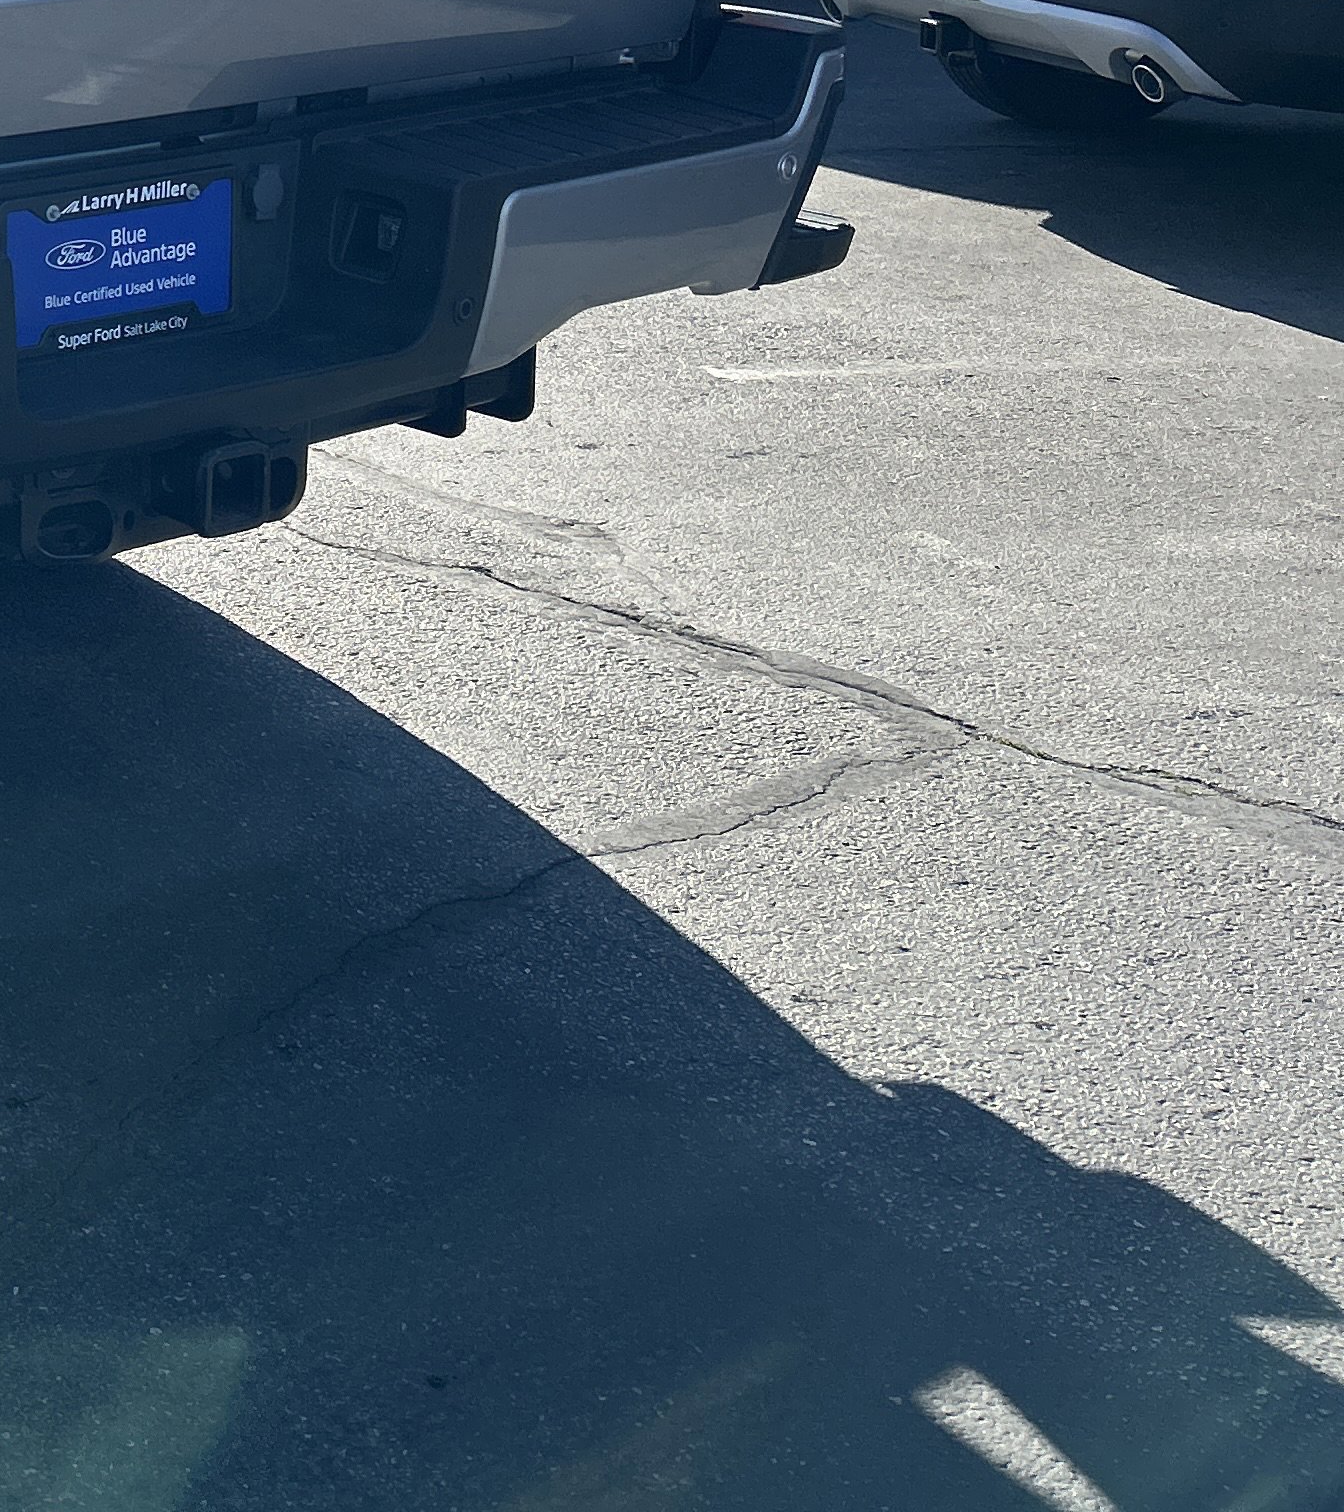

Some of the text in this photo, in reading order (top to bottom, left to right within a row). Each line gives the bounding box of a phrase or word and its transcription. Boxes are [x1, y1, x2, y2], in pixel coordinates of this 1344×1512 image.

[82, 180, 188, 211] Larry H Miller
[111, 226, 147, 247] Blue
[57, 243, 95, 266] Ford
[110, 241, 197, 269] Advantage
[44, 273, 196, 309] Blue Certified Used Vehicle
[57, 315, 188, 350] Super Ford Salt Lake City
